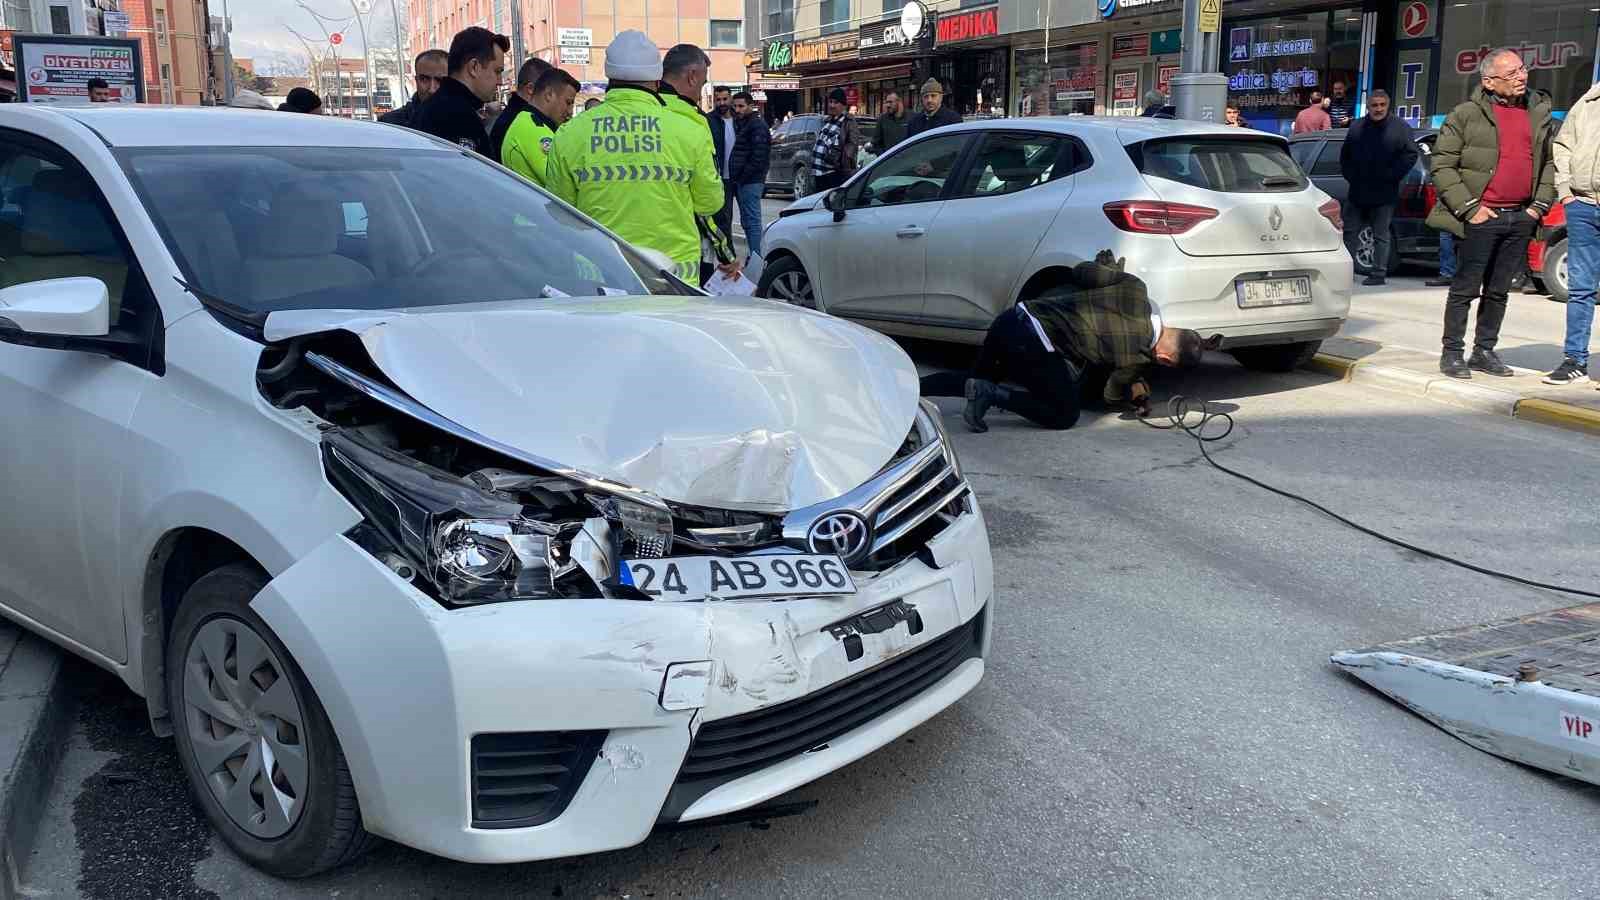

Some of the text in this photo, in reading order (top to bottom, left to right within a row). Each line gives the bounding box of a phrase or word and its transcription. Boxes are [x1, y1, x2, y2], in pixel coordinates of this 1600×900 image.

[938, 7, 998, 42] MEDİKA
[591, 115, 661, 133] TRAFİK
[590, 134, 662, 154] POLİSİ
[1247, 282, 1259, 299] 34
[1289, 279, 1308, 296] 410
[631, 558, 848, 595] 24 AB 966
[1564, 715, 1593, 738] VİP
